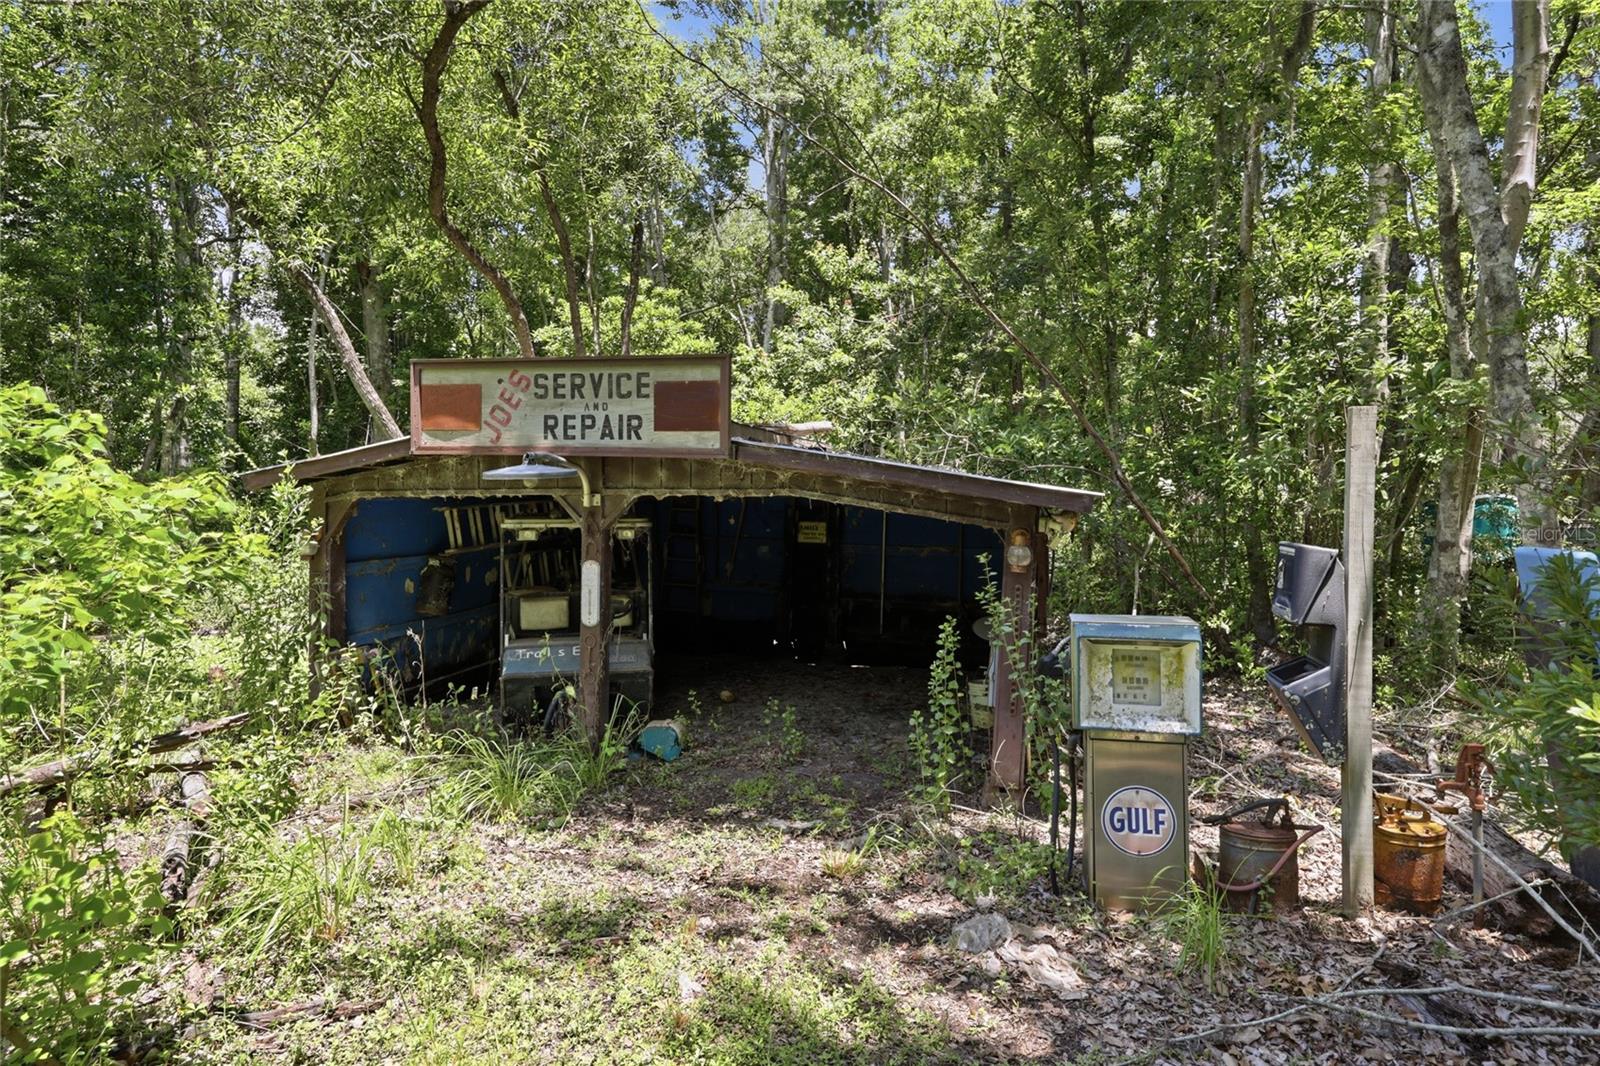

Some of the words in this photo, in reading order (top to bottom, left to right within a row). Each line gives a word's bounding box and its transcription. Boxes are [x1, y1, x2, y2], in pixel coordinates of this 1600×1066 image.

[533, 372, 650, 400] SERVICE
[483, 368, 532, 445] JOES
[584, 402, 608, 412] AND
[543, 414, 643, 441] REPAIR
[1109, 806, 1166, 835] GULF
